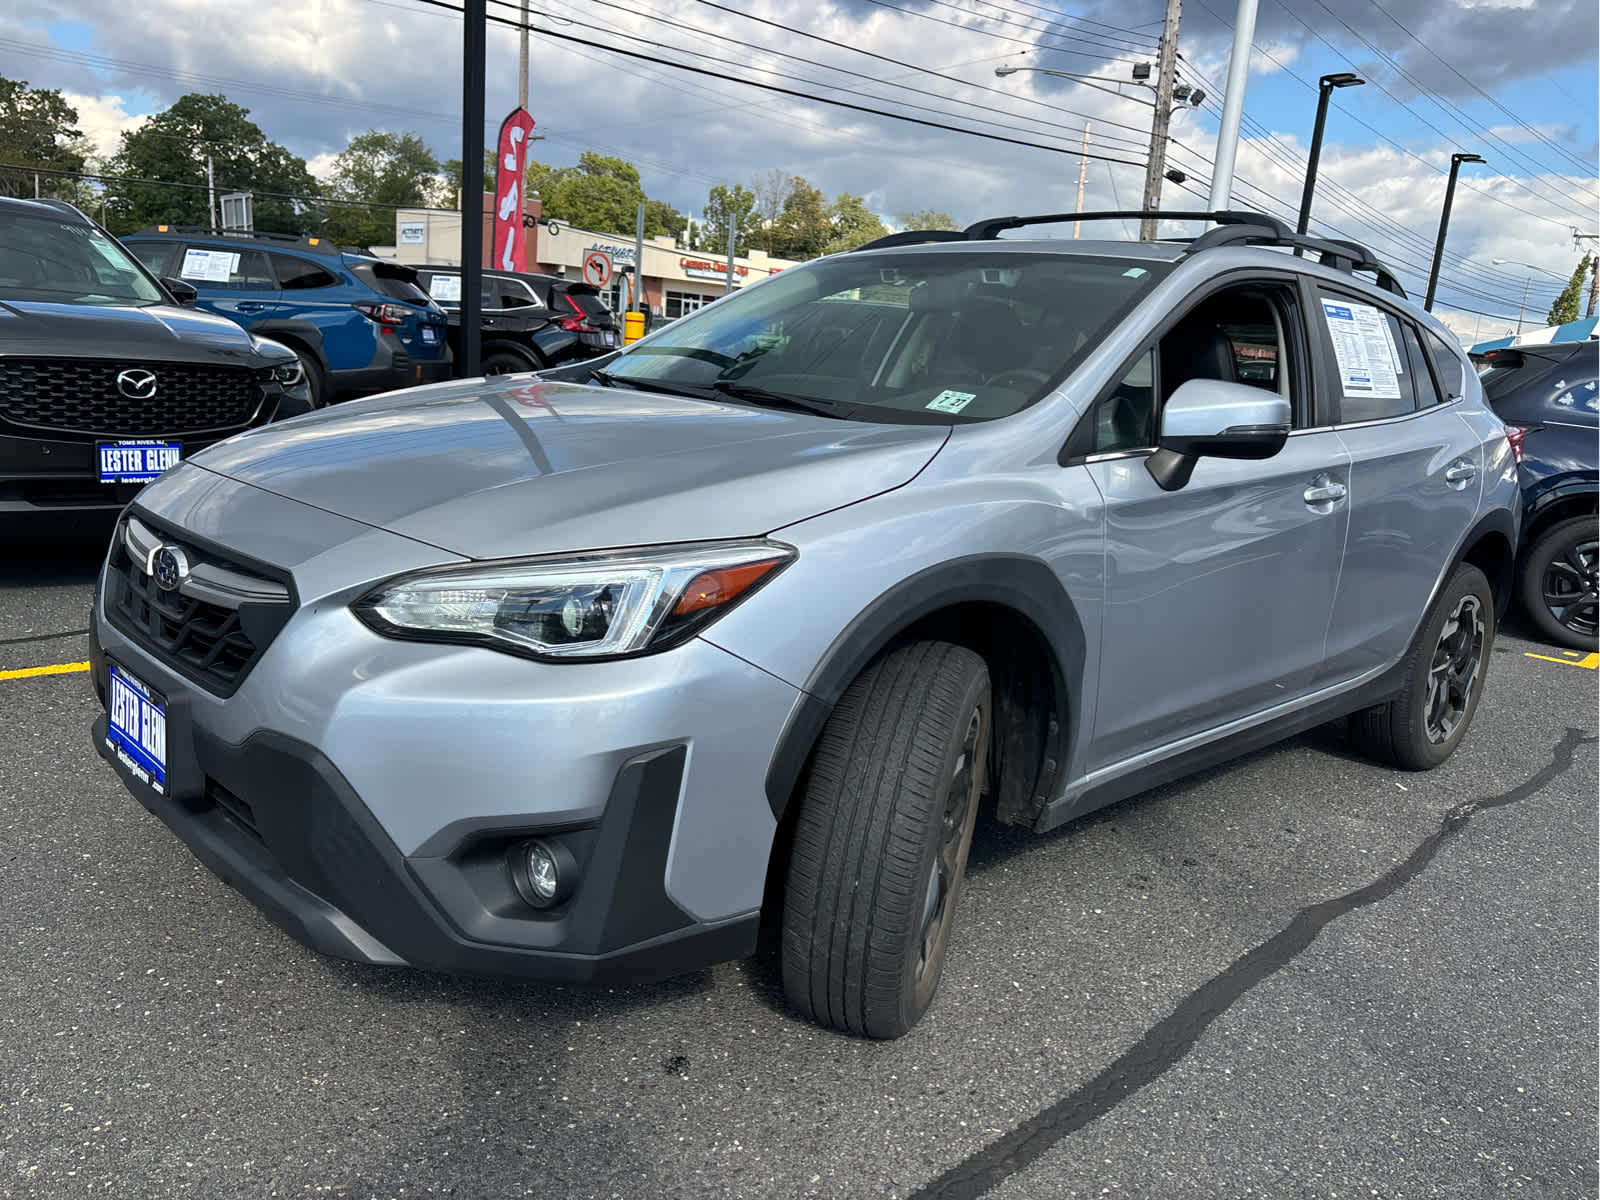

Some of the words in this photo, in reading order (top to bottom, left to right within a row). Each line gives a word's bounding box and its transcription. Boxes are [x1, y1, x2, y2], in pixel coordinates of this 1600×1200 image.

[101, 450, 142, 472] LESTER
[146, 449, 179, 471] GLENN
[111, 677, 140, 742] LESTER
[142, 701, 166, 766] GLENN
